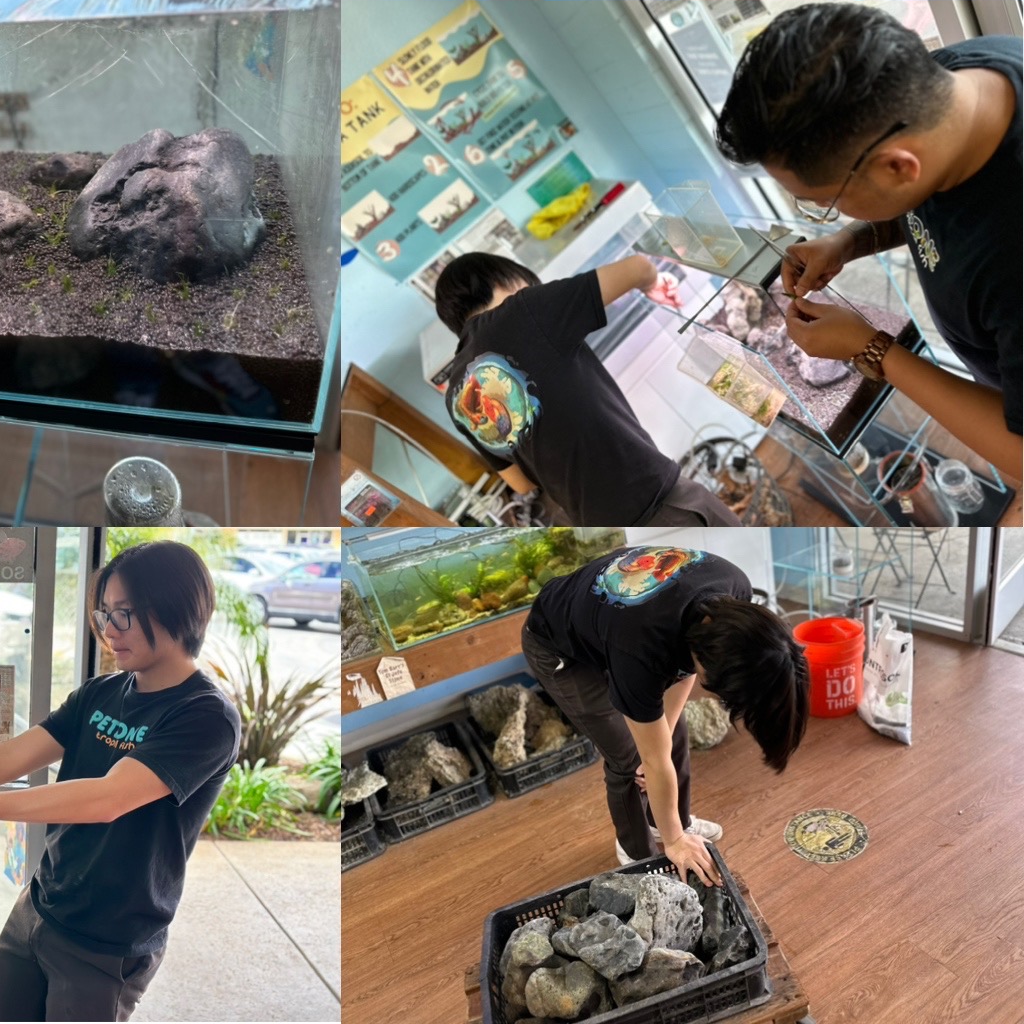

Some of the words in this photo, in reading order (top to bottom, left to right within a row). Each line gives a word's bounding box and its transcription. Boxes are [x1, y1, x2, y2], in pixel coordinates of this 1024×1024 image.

[345, 101, 384, 133] TANK
[826, 663, 856, 679] LET'S
[826, 675, 856, 698] DO
